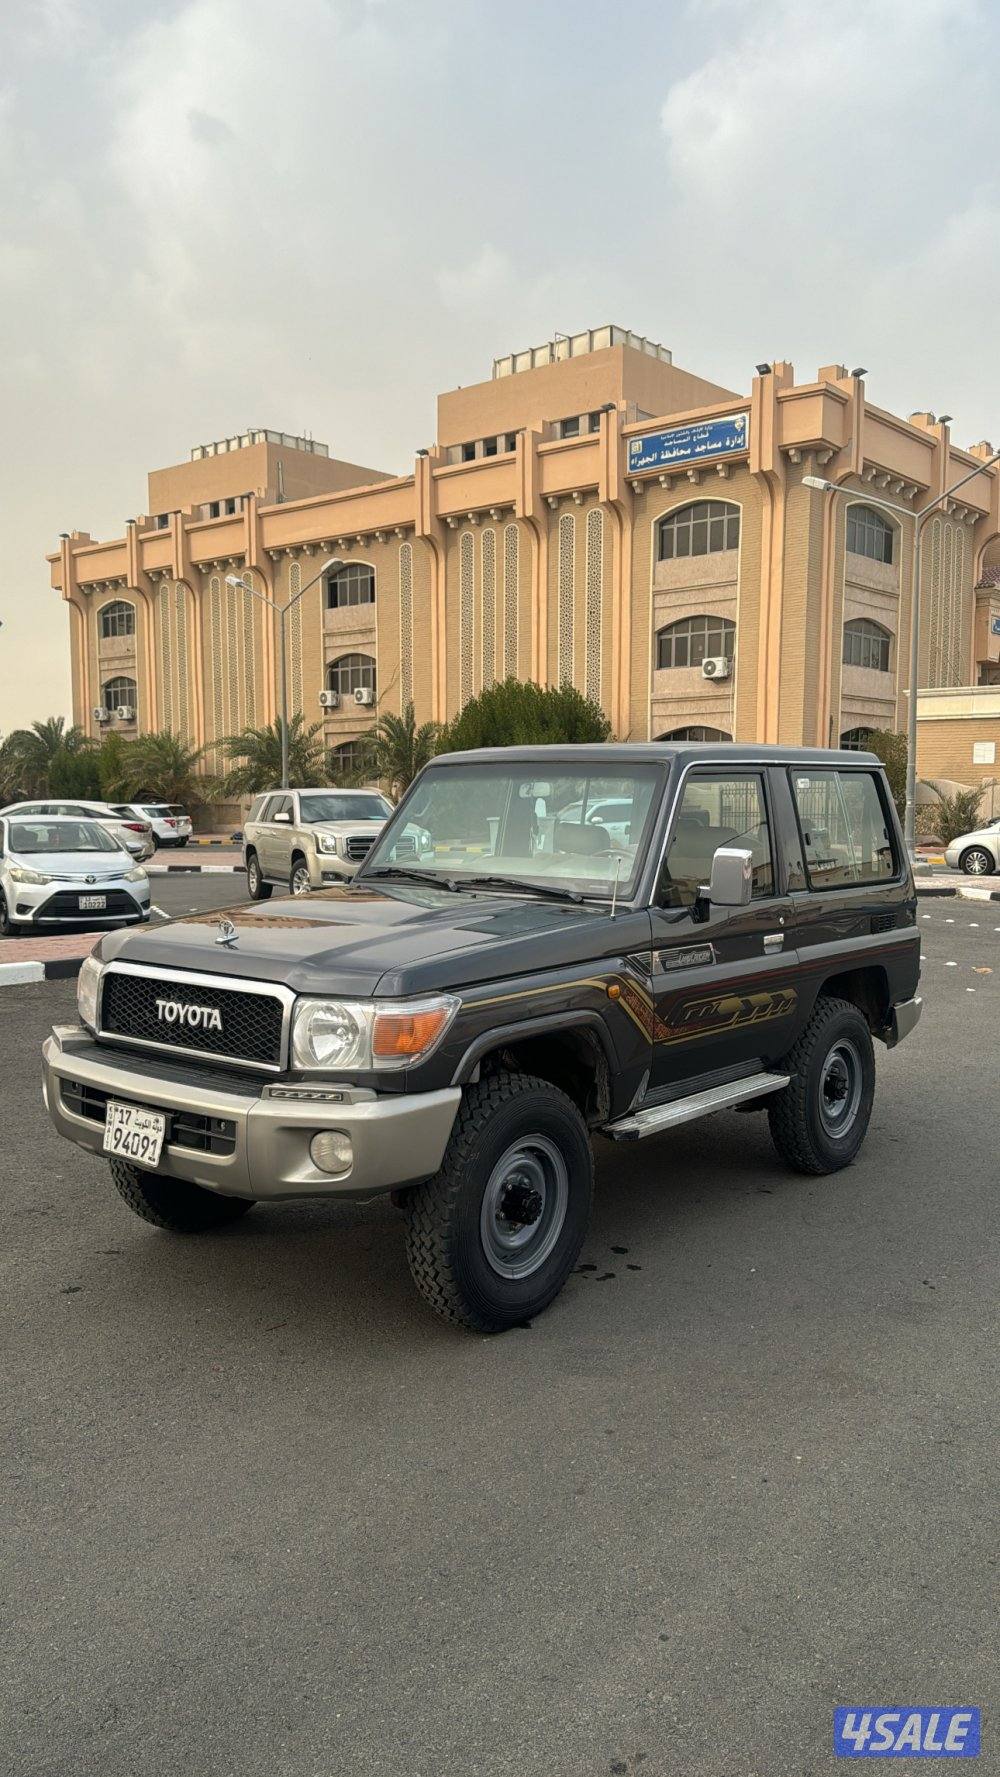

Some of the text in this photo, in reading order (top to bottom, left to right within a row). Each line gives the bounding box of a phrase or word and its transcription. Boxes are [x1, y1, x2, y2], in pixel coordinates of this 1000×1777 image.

[631, 433, 744, 467] إدارة مساجد محافظة الجهراء
[664, 436, 691, 446] المساجد
[156, 1000, 222, 1030] TOYOTA
[118, 1109, 132, 1126] 17
[113, 1127, 158, 1159] 94091
